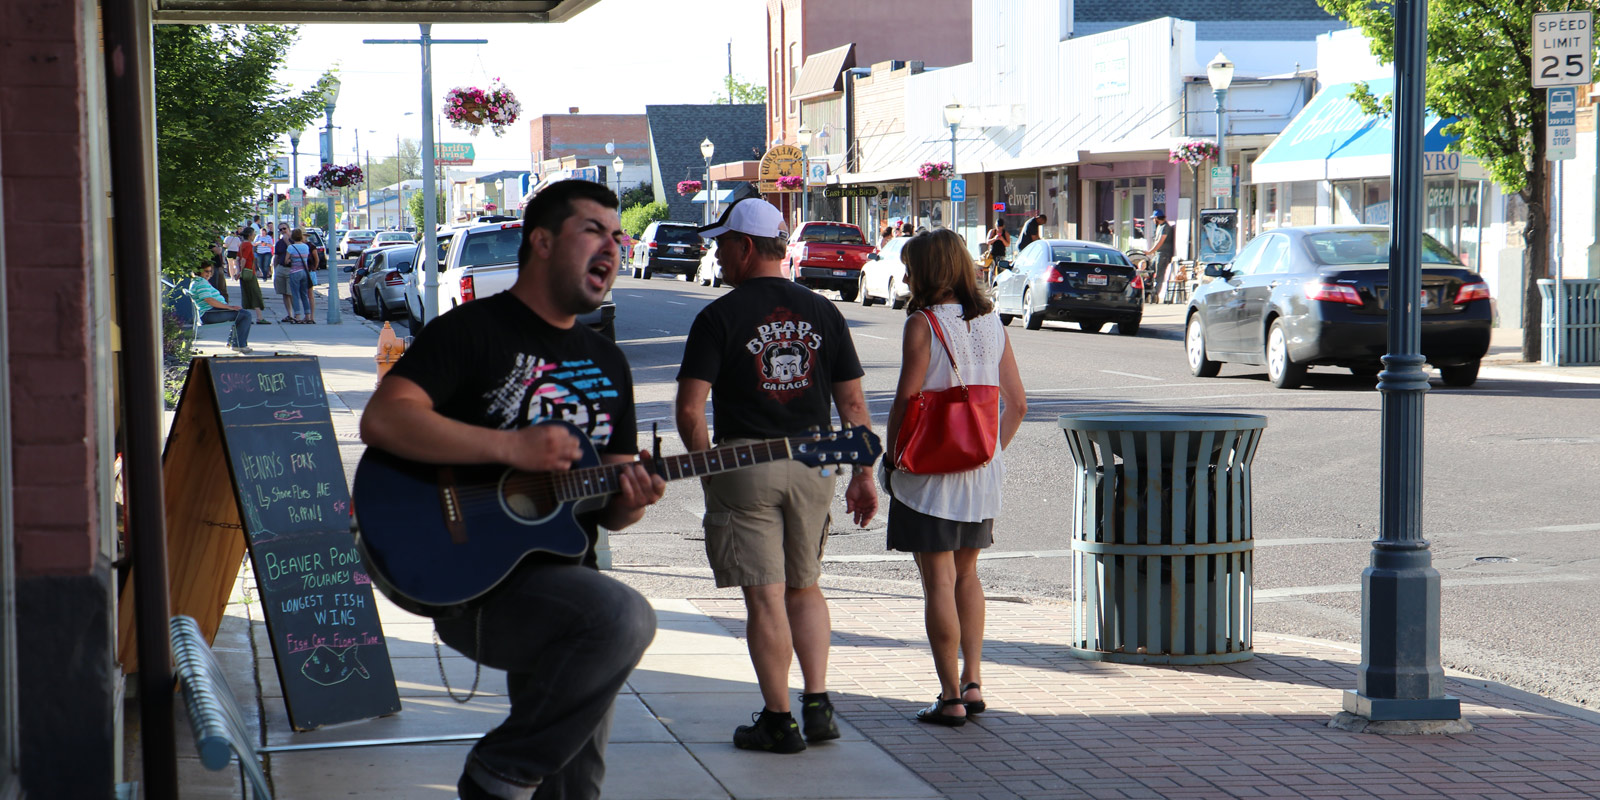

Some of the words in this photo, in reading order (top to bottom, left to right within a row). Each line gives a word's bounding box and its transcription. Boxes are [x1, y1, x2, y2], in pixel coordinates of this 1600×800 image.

[1538, 19, 1587, 32] SPEED
[1543, 37, 1581, 49] LIMIT
[1540, 54, 1584, 78] 25
[1552, 138, 1571, 146] STOP
[1554, 129, 1569, 137] BUS
[434, 144, 470, 153] Thrifty
[1424, 152, 1459, 171] YRO
[1008, 187, 1035, 206] elwen
[757, 321, 812, 334] DEAD
[746, 329, 822, 354] BETTY'S
[220, 372, 255, 394] SNAKE
[257, 372, 287, 392] RIVER
[294, 375, 323, 399] FLY!
[762, 379, 809, 390] GARAGE
[240, 450, 284, 481] HENRY'S
[290, 451, 317, 474] FORK
[316, 482, 331, 499] ARE
[265, 552, 324, 580] BEAVER
[329, 547, 360, 567] POND
[300, 570, 350, 590] TOURNEY
[281, 595, 324, 613] LONGEST
[334, 593, 365, 608] FISH
[314, 609, 356, 626] WINS
